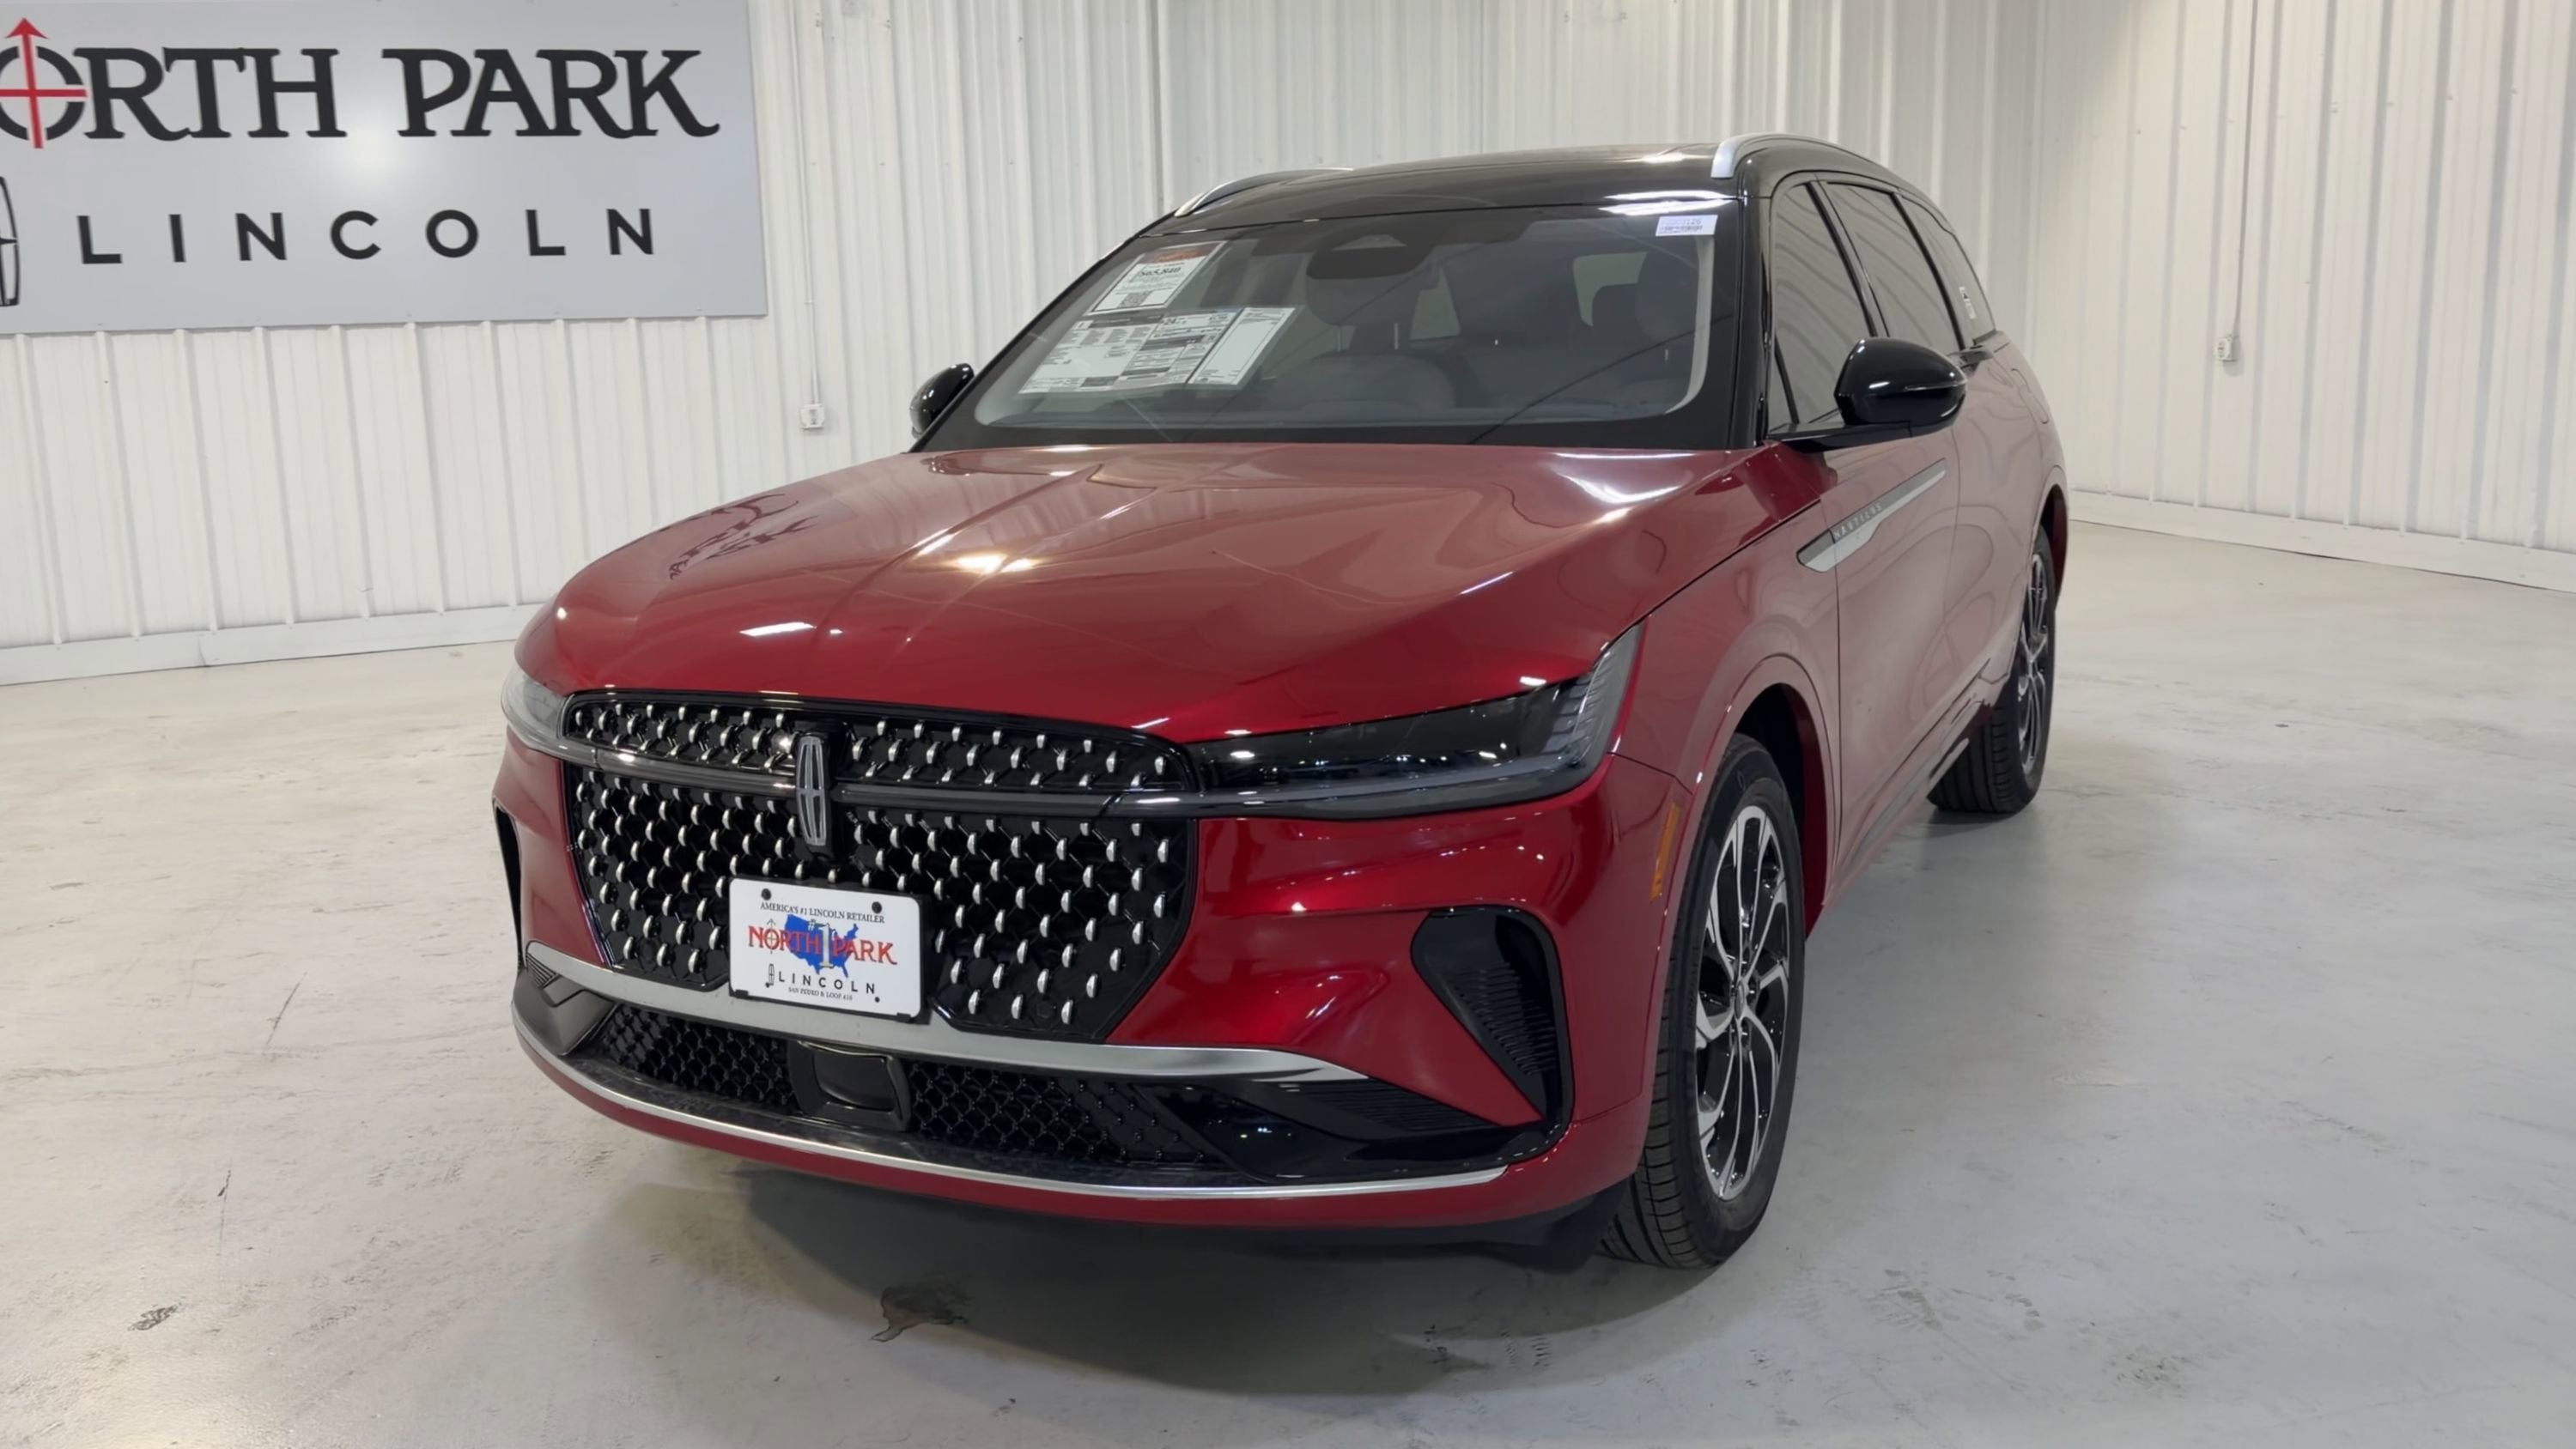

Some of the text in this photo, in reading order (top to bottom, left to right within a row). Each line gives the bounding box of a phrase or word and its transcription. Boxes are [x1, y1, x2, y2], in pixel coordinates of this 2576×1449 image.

[382, 49, 720, 140] PARK
[77, 208, 655, 265] LINCOLN
[1833, 501, 1882, 538] NAUTILUS
[760, 901, 799, 914] AMERICA'S
[809, 907, 845, 919] LINCOLN
[847, 912, 885, 924] RETAILER
[748, 925, 821, 955] NORTH
[833, 935, 898, 965] PARK
[778, 971, 875, 995] LINCOLN
